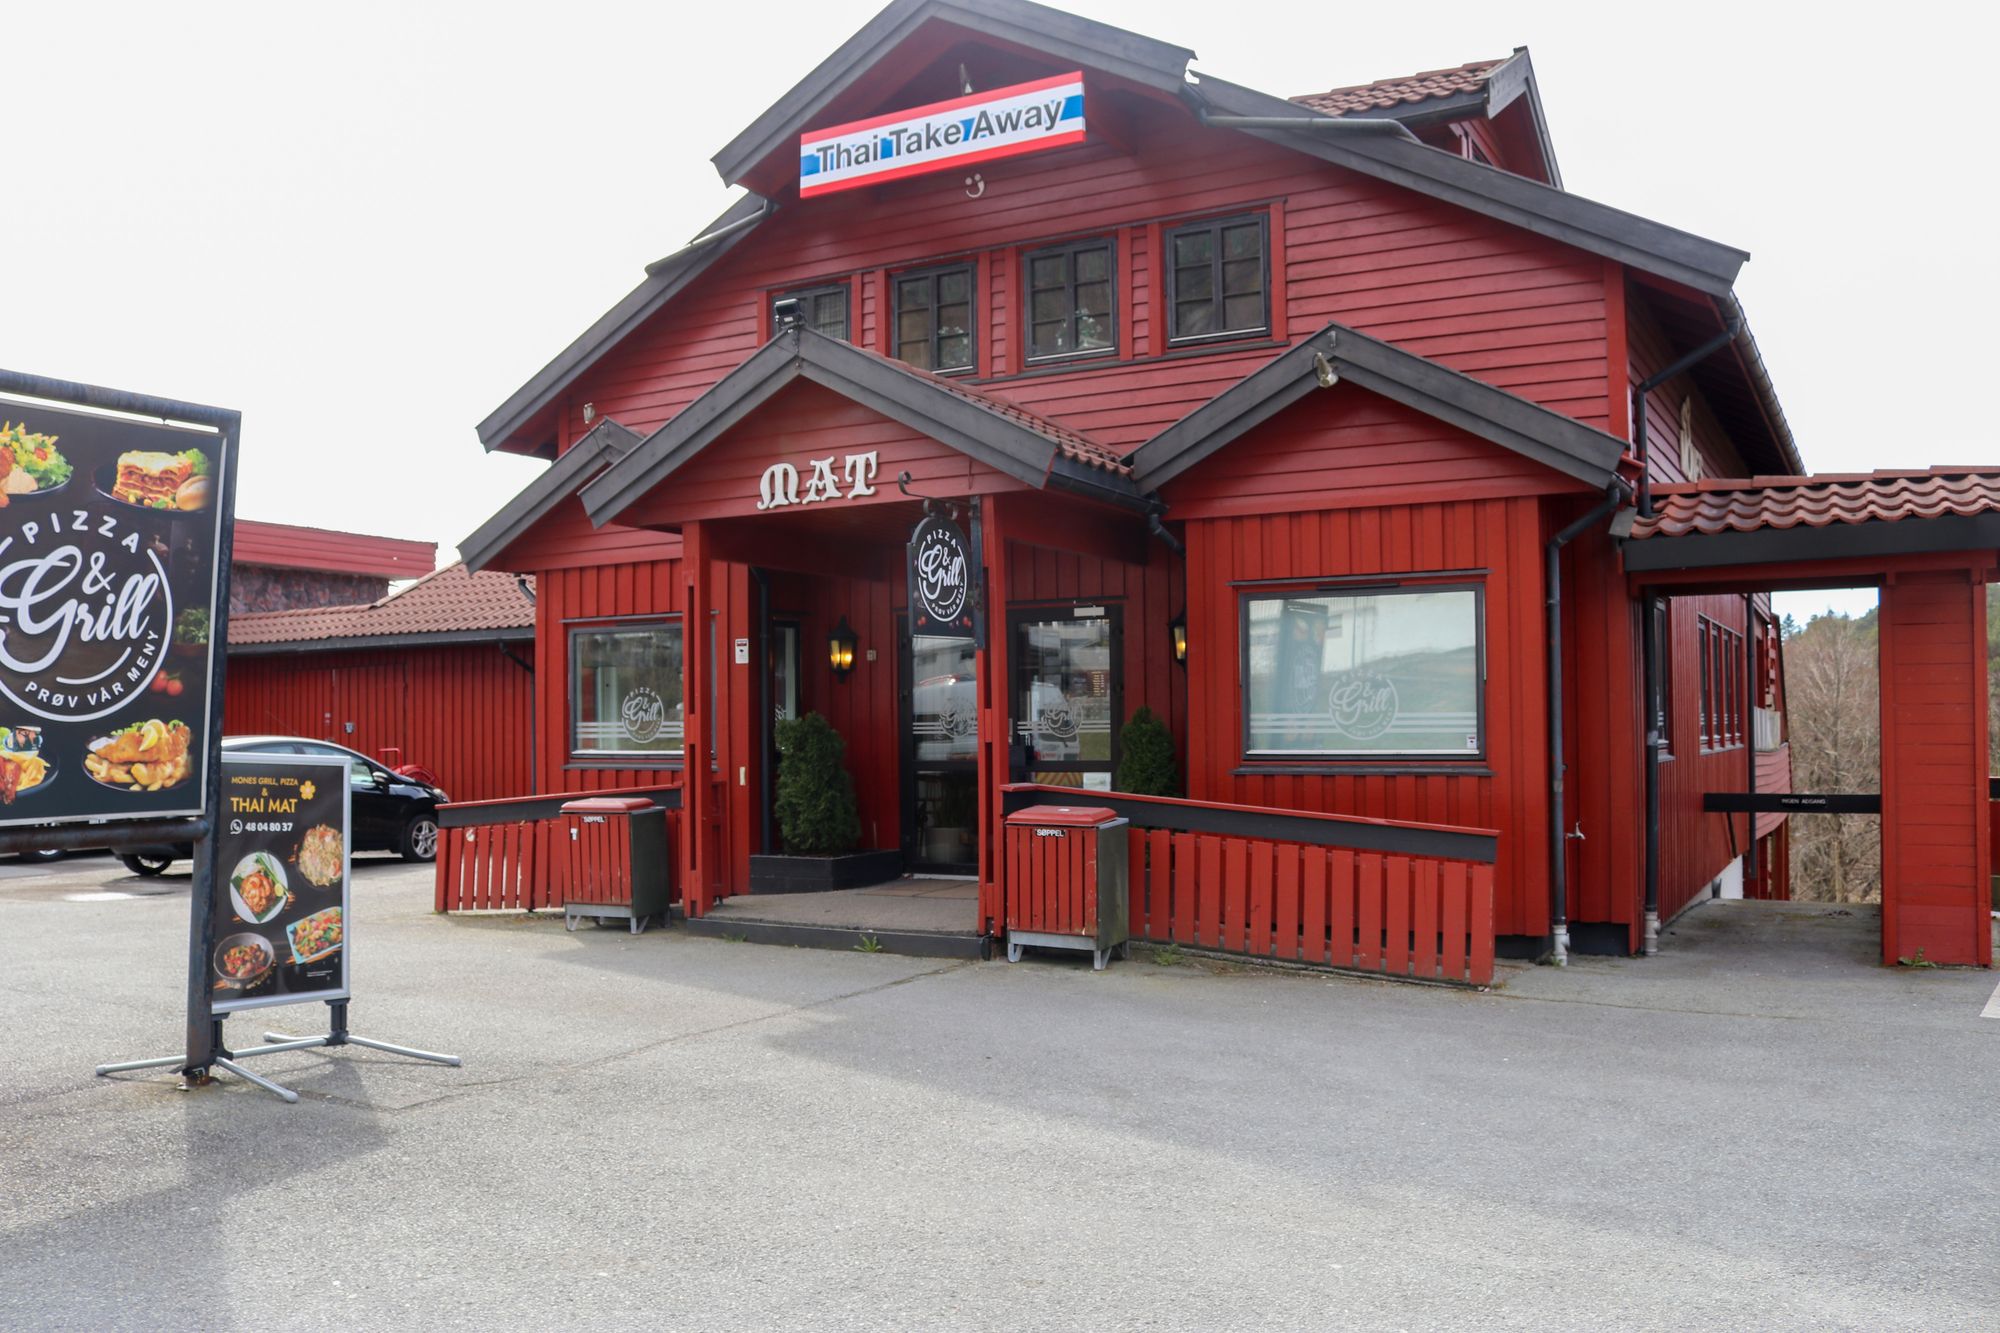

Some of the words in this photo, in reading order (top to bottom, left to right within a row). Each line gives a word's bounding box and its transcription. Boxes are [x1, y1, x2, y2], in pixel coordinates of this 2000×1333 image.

[816, 134, 879, 173] Thai
[889, 122, 962, 157] Take
[971, 99, 1063, 140] Away
[756, 450, 878, 511] MAT
[21, 510, 140, 554] PIZZA
[926, 529, 957, 548] PIZZA
[81, 551, 117, 595] &
[921, 544, 963, 600] Grill
[942, 546, 952, 566] &
[0, 545, 160, 673] Grill
[24, 681, 79, 708] PRØV
[86, 682, 125, 706] VÅR
[126, 629, 160, 683] MENY
[624, 696, 660, 730] Grill
[1332, 680, 1392, 725] Grill
[230, 797, 264, 813] THAI
[268, 798, 298, 813] MAT
[245, 822, 257, 831] 48
[257, 822, 268, 831] 04
[269, 822, 281, 831] 80
[282, 822, 293, 831] 37
